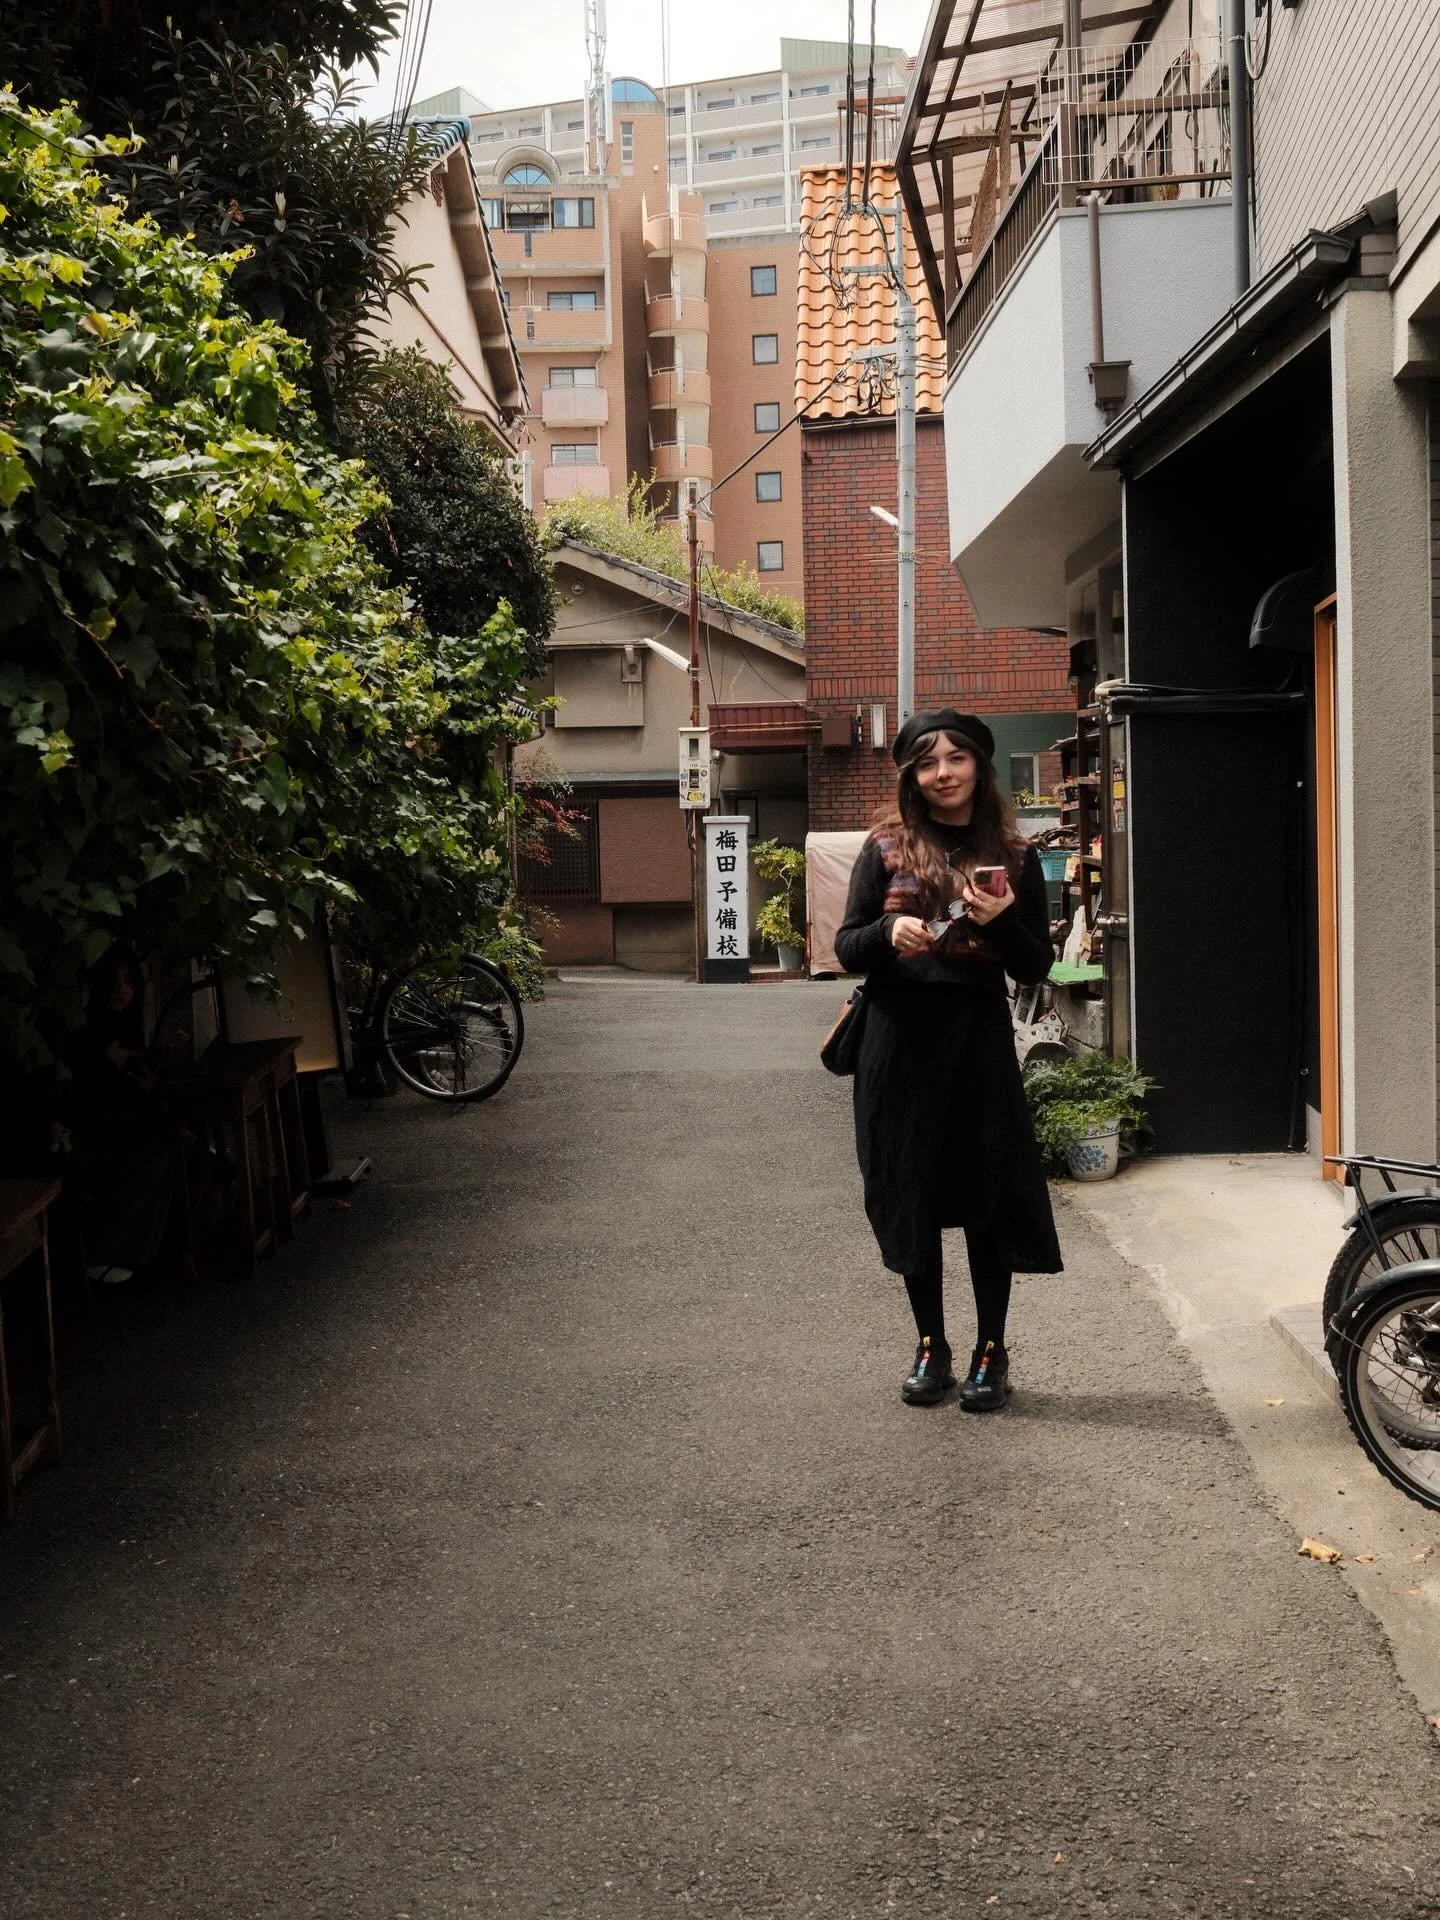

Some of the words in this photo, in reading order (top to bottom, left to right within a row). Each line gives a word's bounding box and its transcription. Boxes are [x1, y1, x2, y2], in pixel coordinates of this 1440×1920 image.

[715, 830, 739, 956] 梅田予備校
